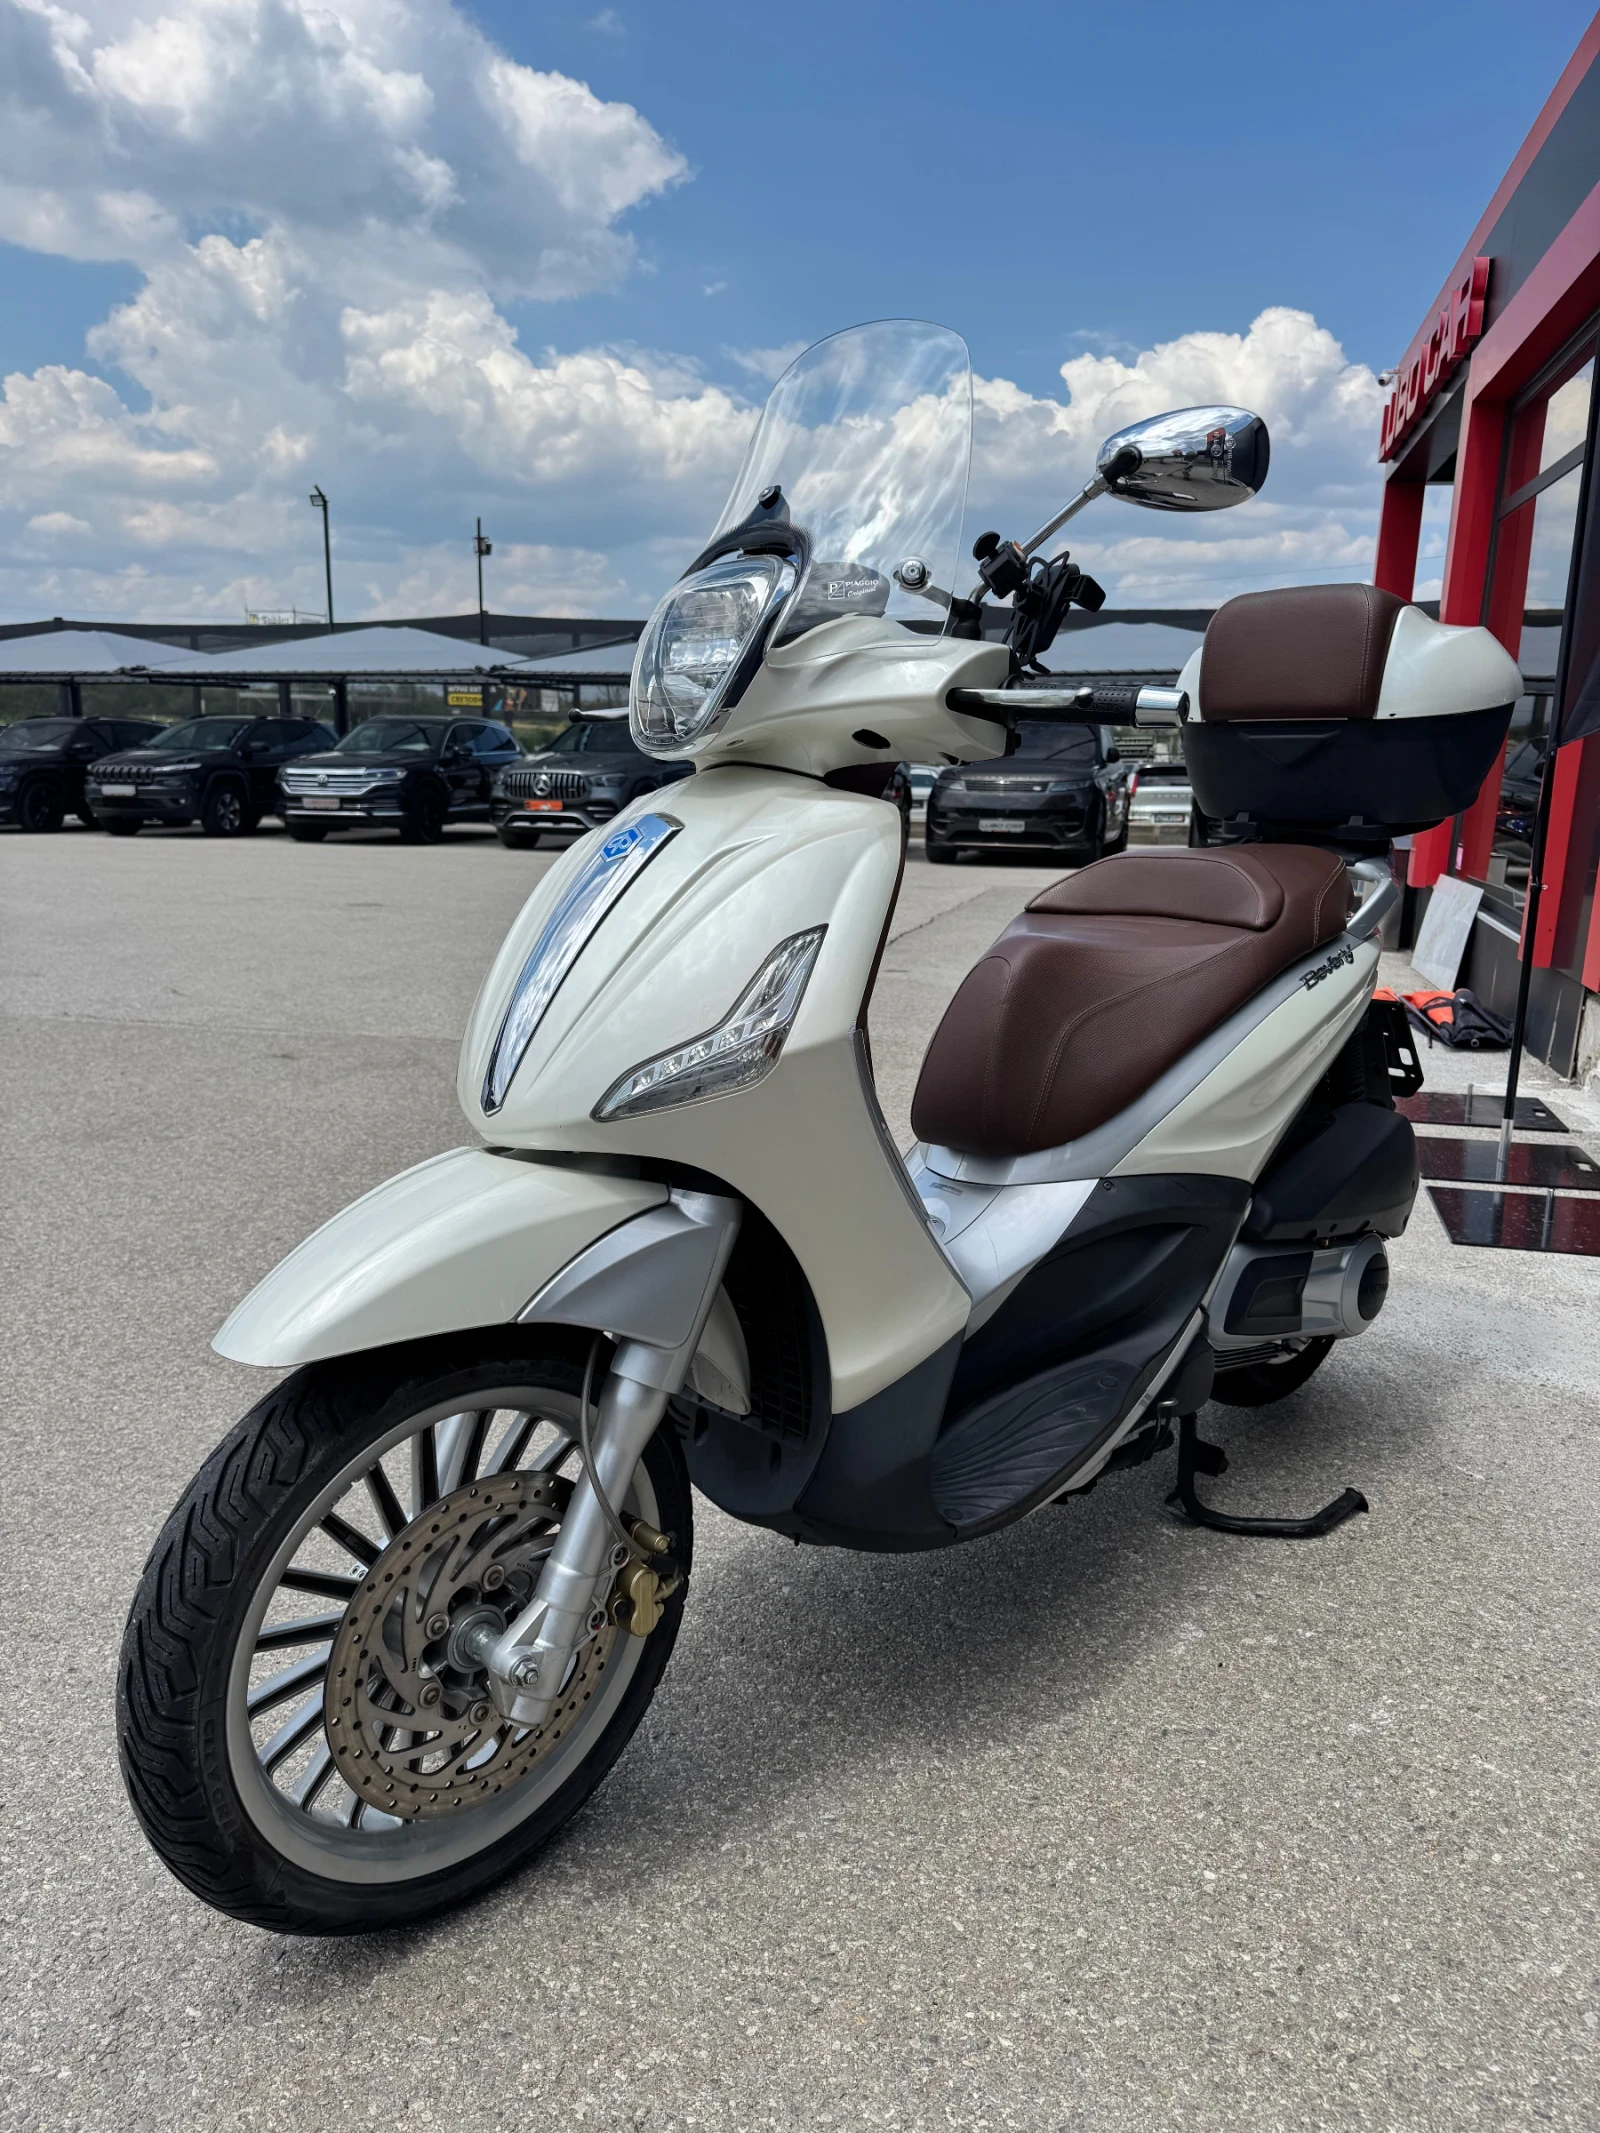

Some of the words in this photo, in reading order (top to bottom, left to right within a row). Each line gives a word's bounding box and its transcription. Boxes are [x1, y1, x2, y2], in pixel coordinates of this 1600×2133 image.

[1424, 257, 1489, 396] CAR
[848, 586, 876, 597] Original
[1298, 944, 1355, 991] Beverly
